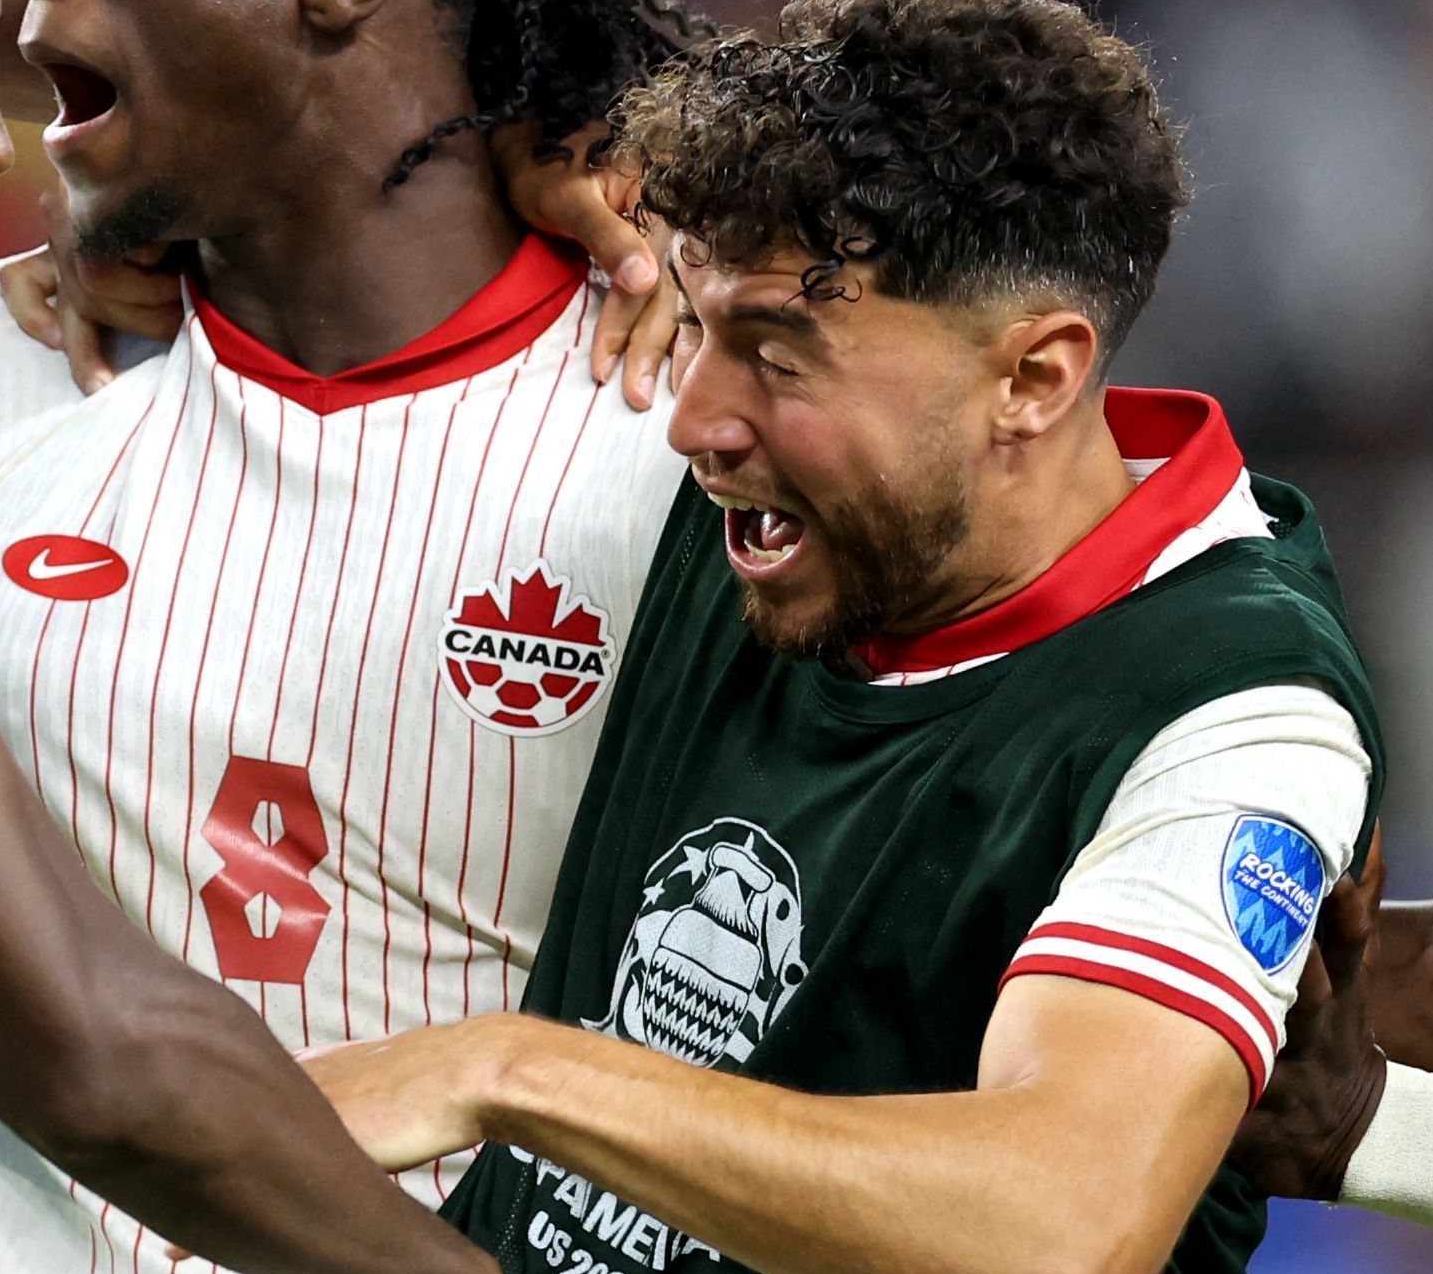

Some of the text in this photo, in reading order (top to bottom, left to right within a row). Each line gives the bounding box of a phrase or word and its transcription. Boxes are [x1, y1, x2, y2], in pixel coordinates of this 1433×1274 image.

[445, 629, 605, 676] CANADA
[200, 754, 332, 985] 8
[1235, 870, 1308, 928] THE CONTINENT
[1239, 853, 1314, 915] ROCKING
